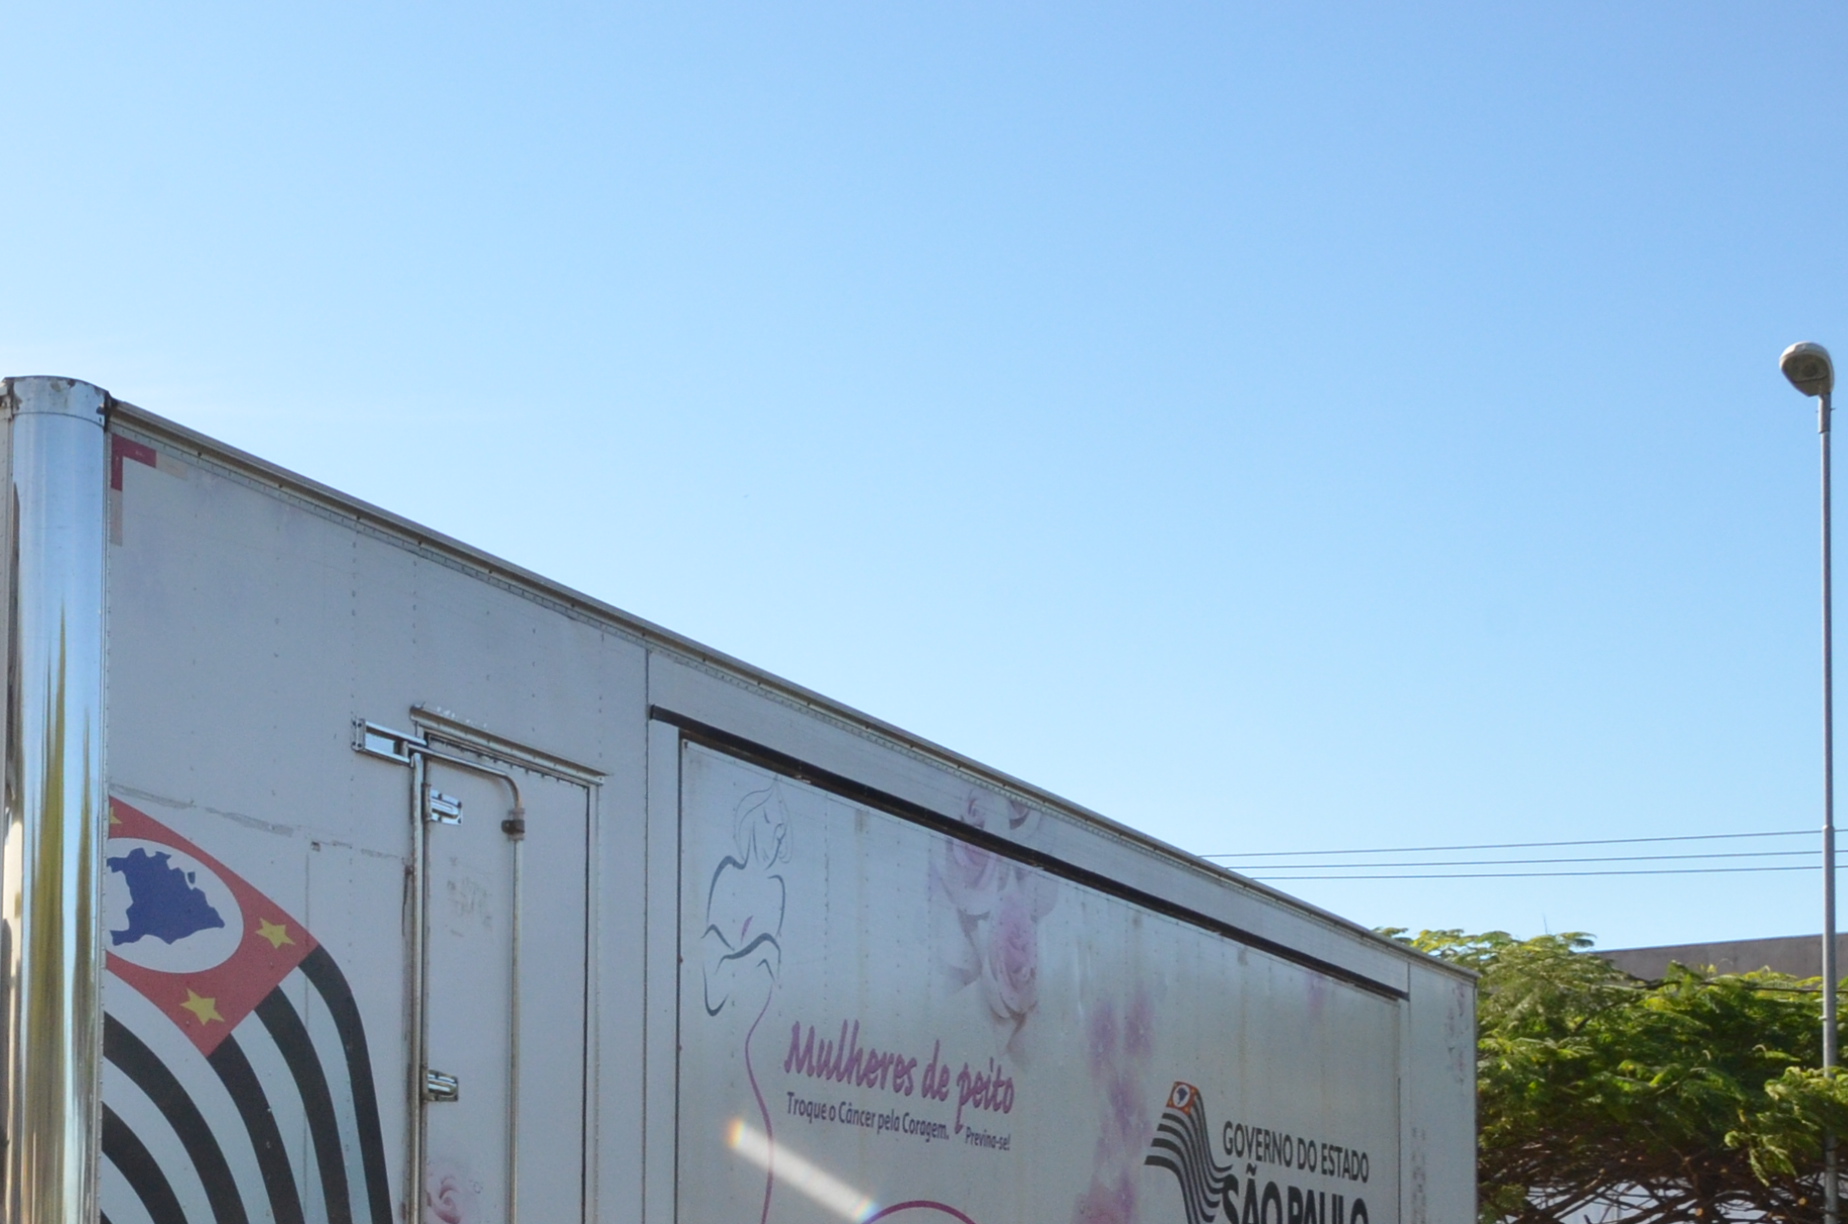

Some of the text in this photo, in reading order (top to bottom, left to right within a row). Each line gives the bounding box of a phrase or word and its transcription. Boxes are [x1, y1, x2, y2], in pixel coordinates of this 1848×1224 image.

[784, 1019, 1015, 1134] Mulheres de peito
[786, 1091, 950, 1142] Troque o Câncer pela Coragem.
[964, 1126, 1011, 1151] Previna-se!
[1223, 1121, 1369, 1184] GOVERNO DO ESTADO
